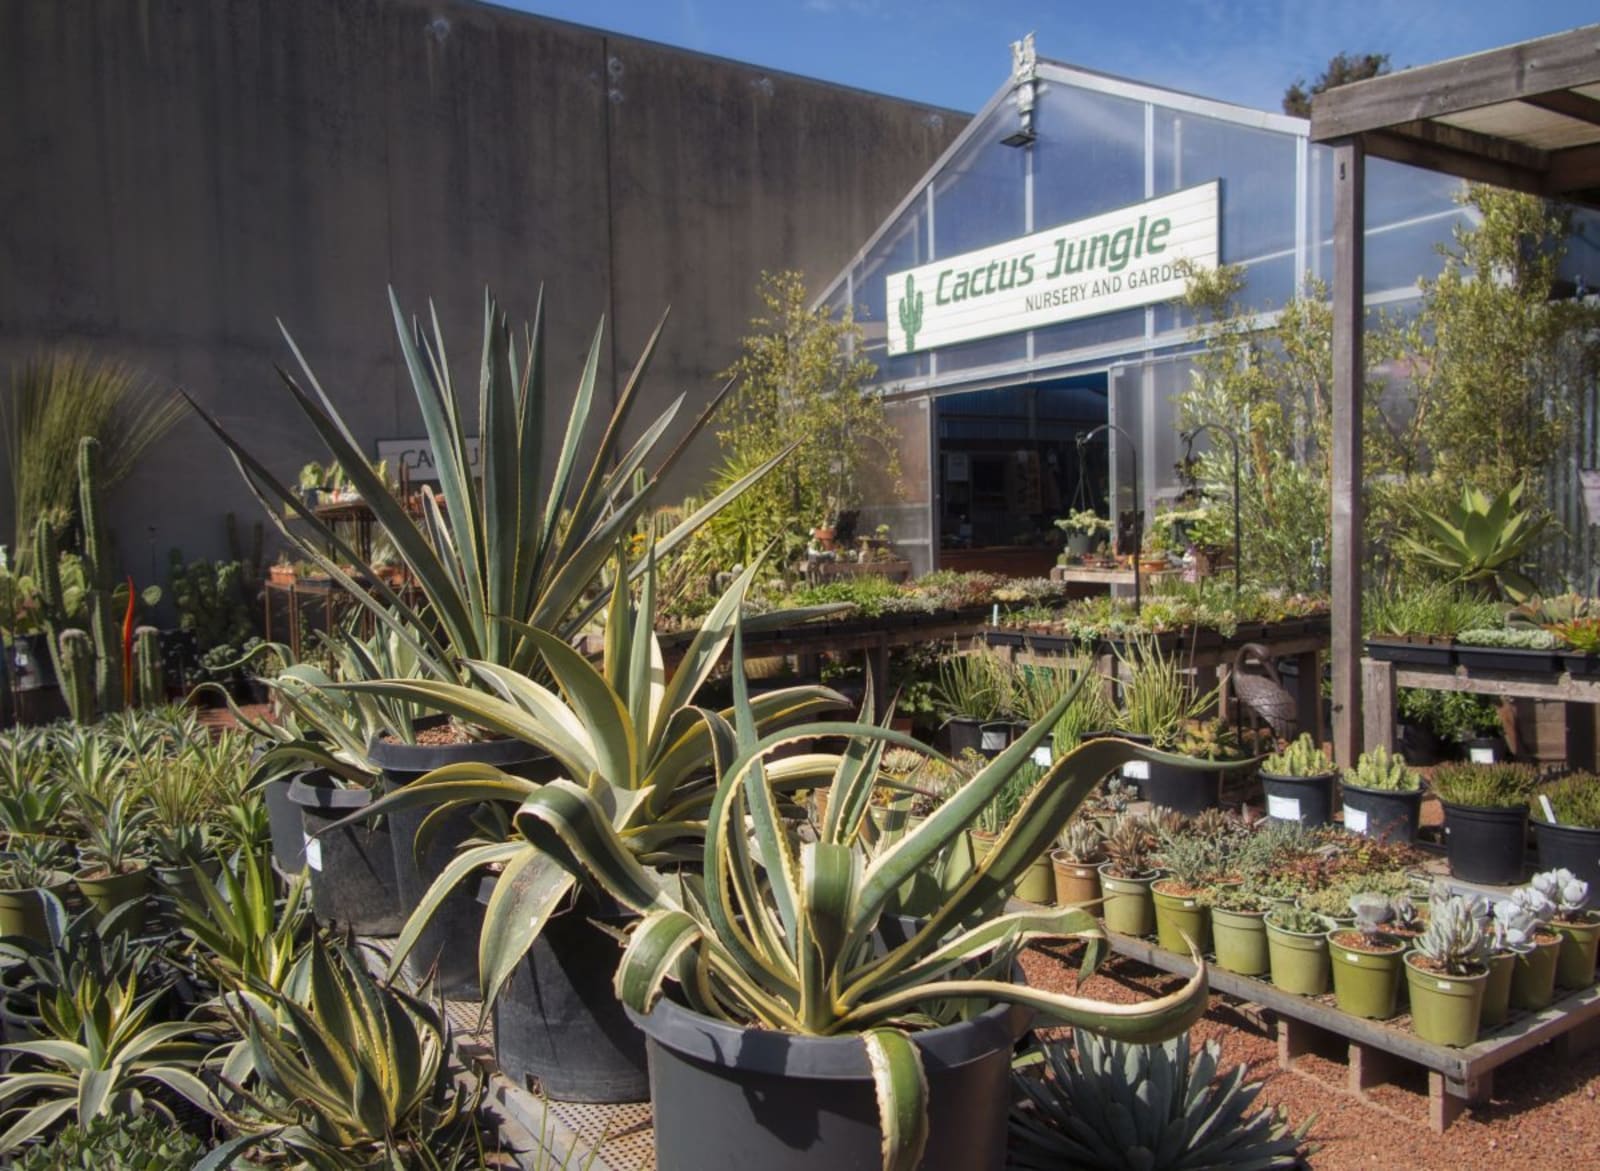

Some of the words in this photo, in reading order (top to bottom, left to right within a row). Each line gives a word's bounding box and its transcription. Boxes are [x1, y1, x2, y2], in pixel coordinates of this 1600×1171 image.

[936, 253, 1035, 305] Cactus
[1046, 215, 1171, 279] Jungle
[1025, 284, 1087, 312] NURSERY
[1091, 276, 1122, 298] AND
